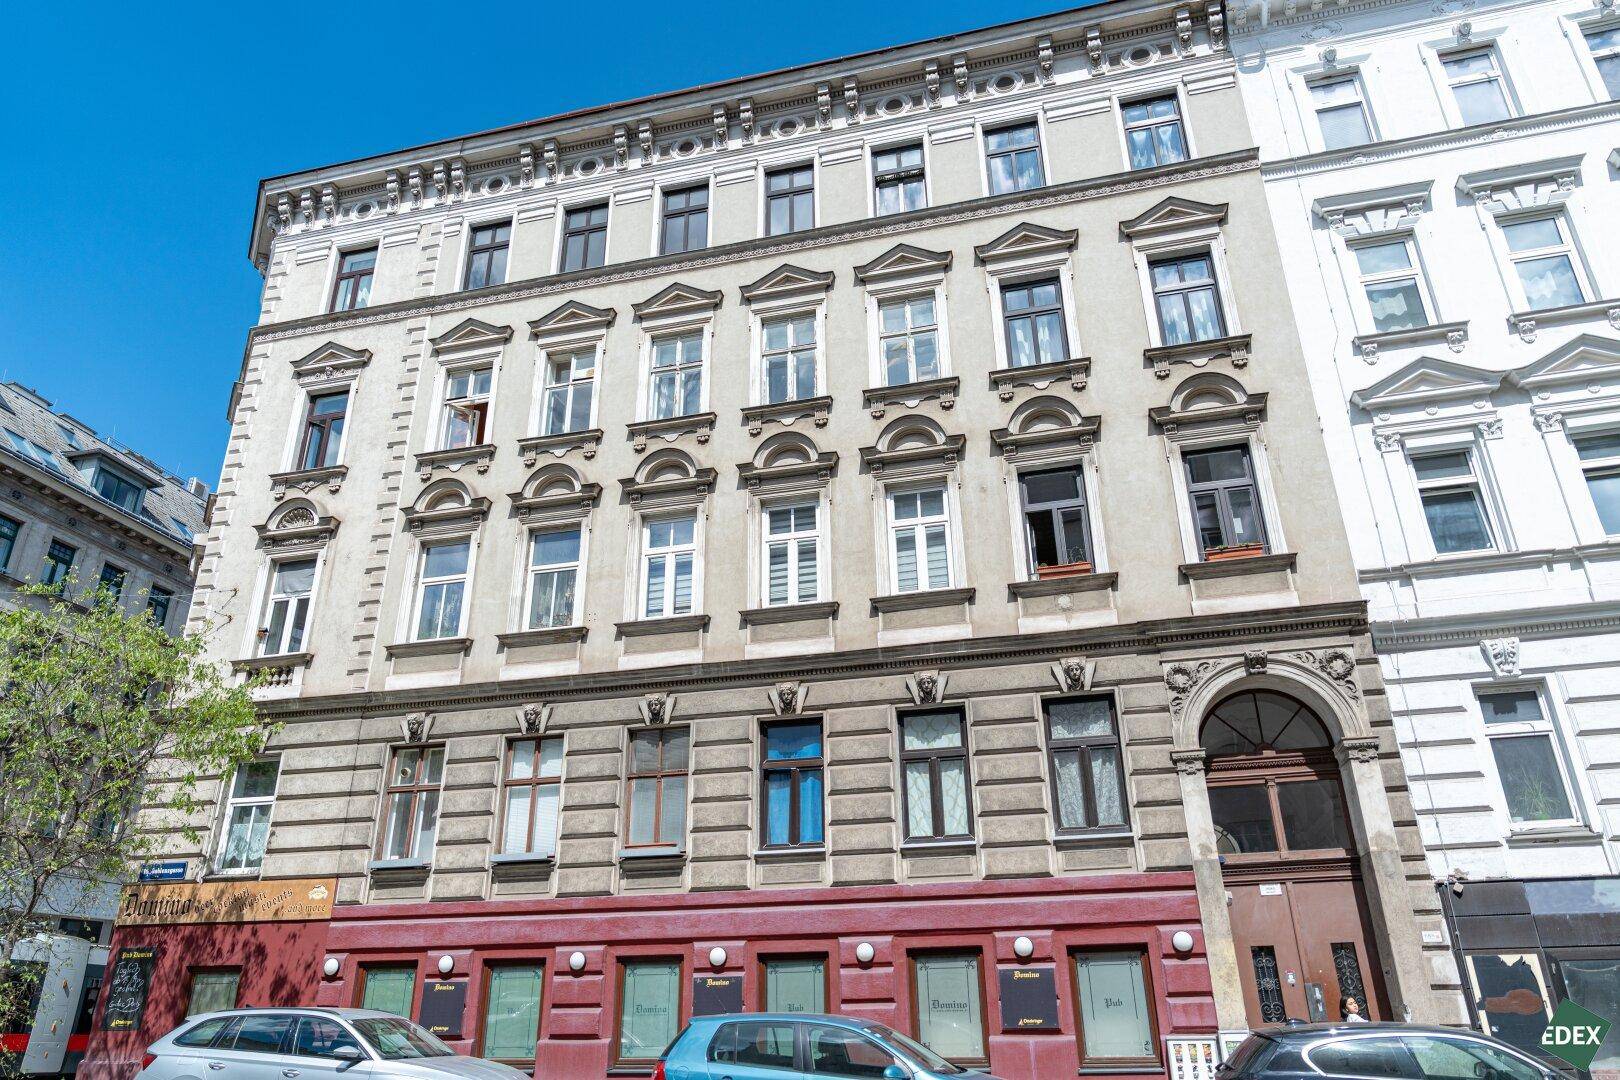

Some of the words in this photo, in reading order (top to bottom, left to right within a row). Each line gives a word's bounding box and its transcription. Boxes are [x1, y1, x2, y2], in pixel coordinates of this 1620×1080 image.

[124, 893, 192, 917] Domino
[262, 888, 293, 912] events
[305, 904, 326, 913] more
[1013, 970, 1040, 980] Domino
[433, 983, 455, 992] Domino
[706, 978, 730, 988] Domino
[787, 1003, 804, 1012] Pub
[931, 999, 968, 1009] Domino
[1104, 997, 1123, 1009] Pub
[635, 1004, 667, 1013] Domino
